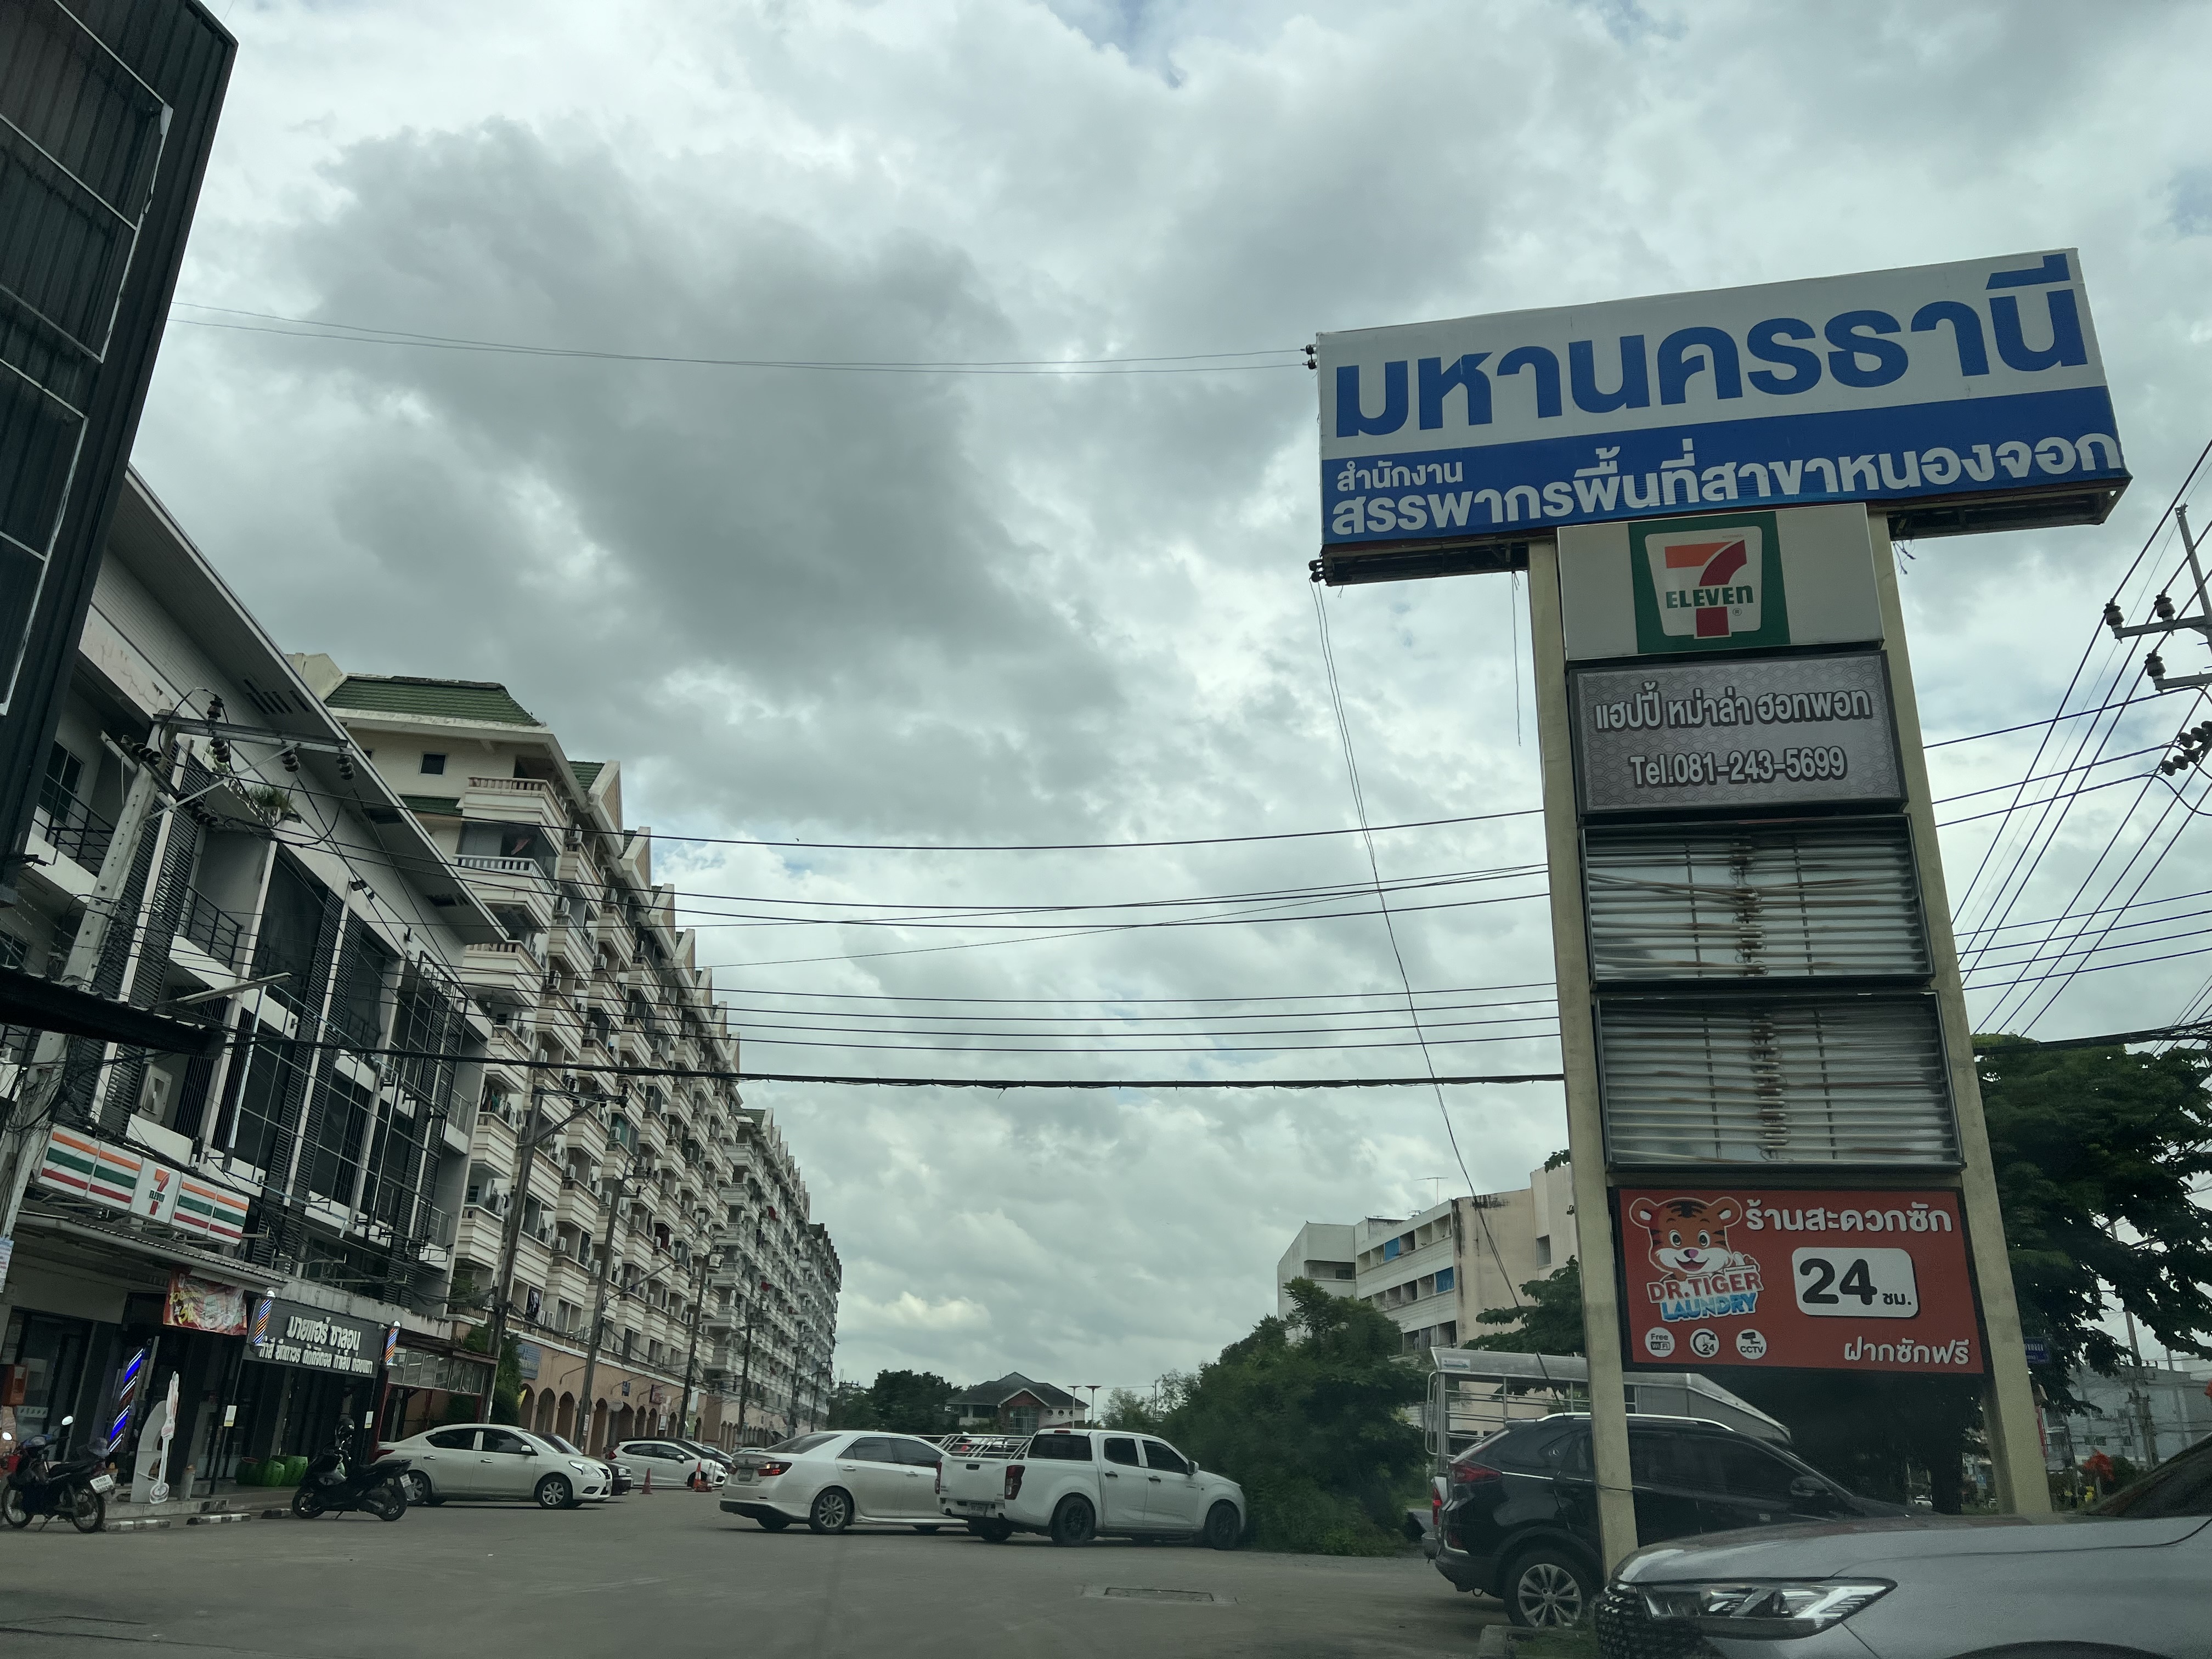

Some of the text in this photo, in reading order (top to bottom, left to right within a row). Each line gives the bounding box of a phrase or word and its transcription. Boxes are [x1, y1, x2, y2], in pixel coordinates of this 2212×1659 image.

[1335, 253, 2089, 437] มหานครธานี
[1332, 433, 2121, 535] สรรพากรพื้นที่สาขาหนองจอก
[1337, 460, 1463, 492] สำนักงาน
[1664, 539, 1747, 636] 7
[1596, 682, 1870, 729] แฮปปี้ หม่าล่า ฮอทพอท
[1630, 746, 1844, 785] Tel.081-243-5699
[1746, 1199, 1952, 1232] ร้านสะดวกซัก
[1649, 1272, 1762, 1301] DR.TIGER
[1799, 1258, 1912, 1305] 24 ชม.
[1662, 1293, 1756, 1320] LAUNDRY
[1702, 1344, 1715, 1352] 24
[1844, 1336, 1970, 1365] ฝากซักฟรี
